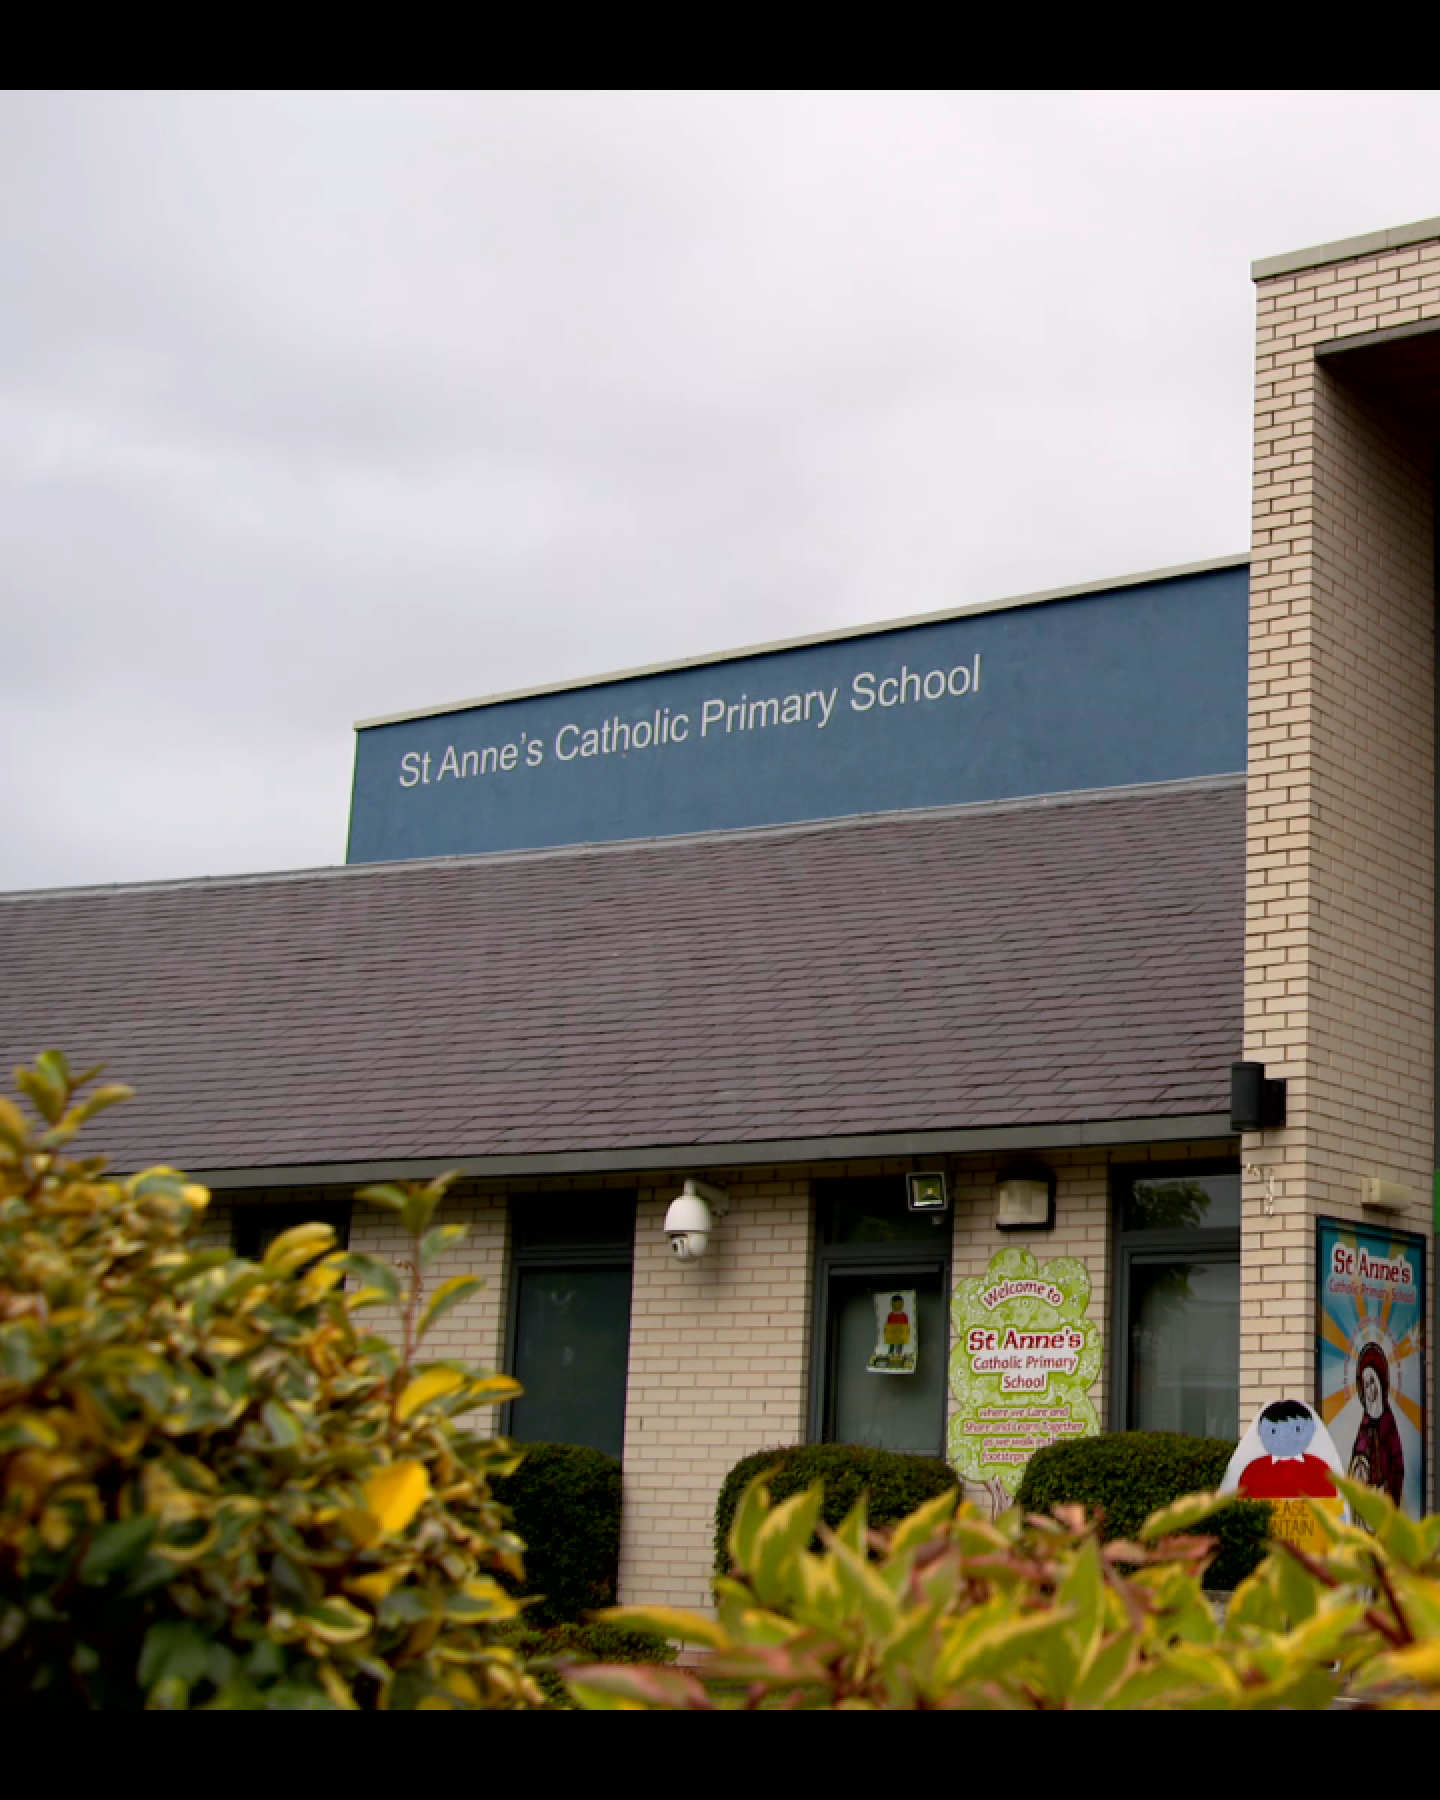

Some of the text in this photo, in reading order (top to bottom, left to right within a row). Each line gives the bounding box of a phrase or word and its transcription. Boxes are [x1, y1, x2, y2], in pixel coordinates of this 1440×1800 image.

[399, 653, 981, 788] St Anne's Catholic Primary School
[1333, 1247, 1412, 1285] St Anne's
[983, 1281, 1063, 1307] Welcome to
[1329, 1277, 1359, 1296] Catholic
[969, 1328, 1082, 1351] St Anne's
[973, 1355, 1077, 1373] Catholic Primary
[1003, 1373, 1046, 1389] School
